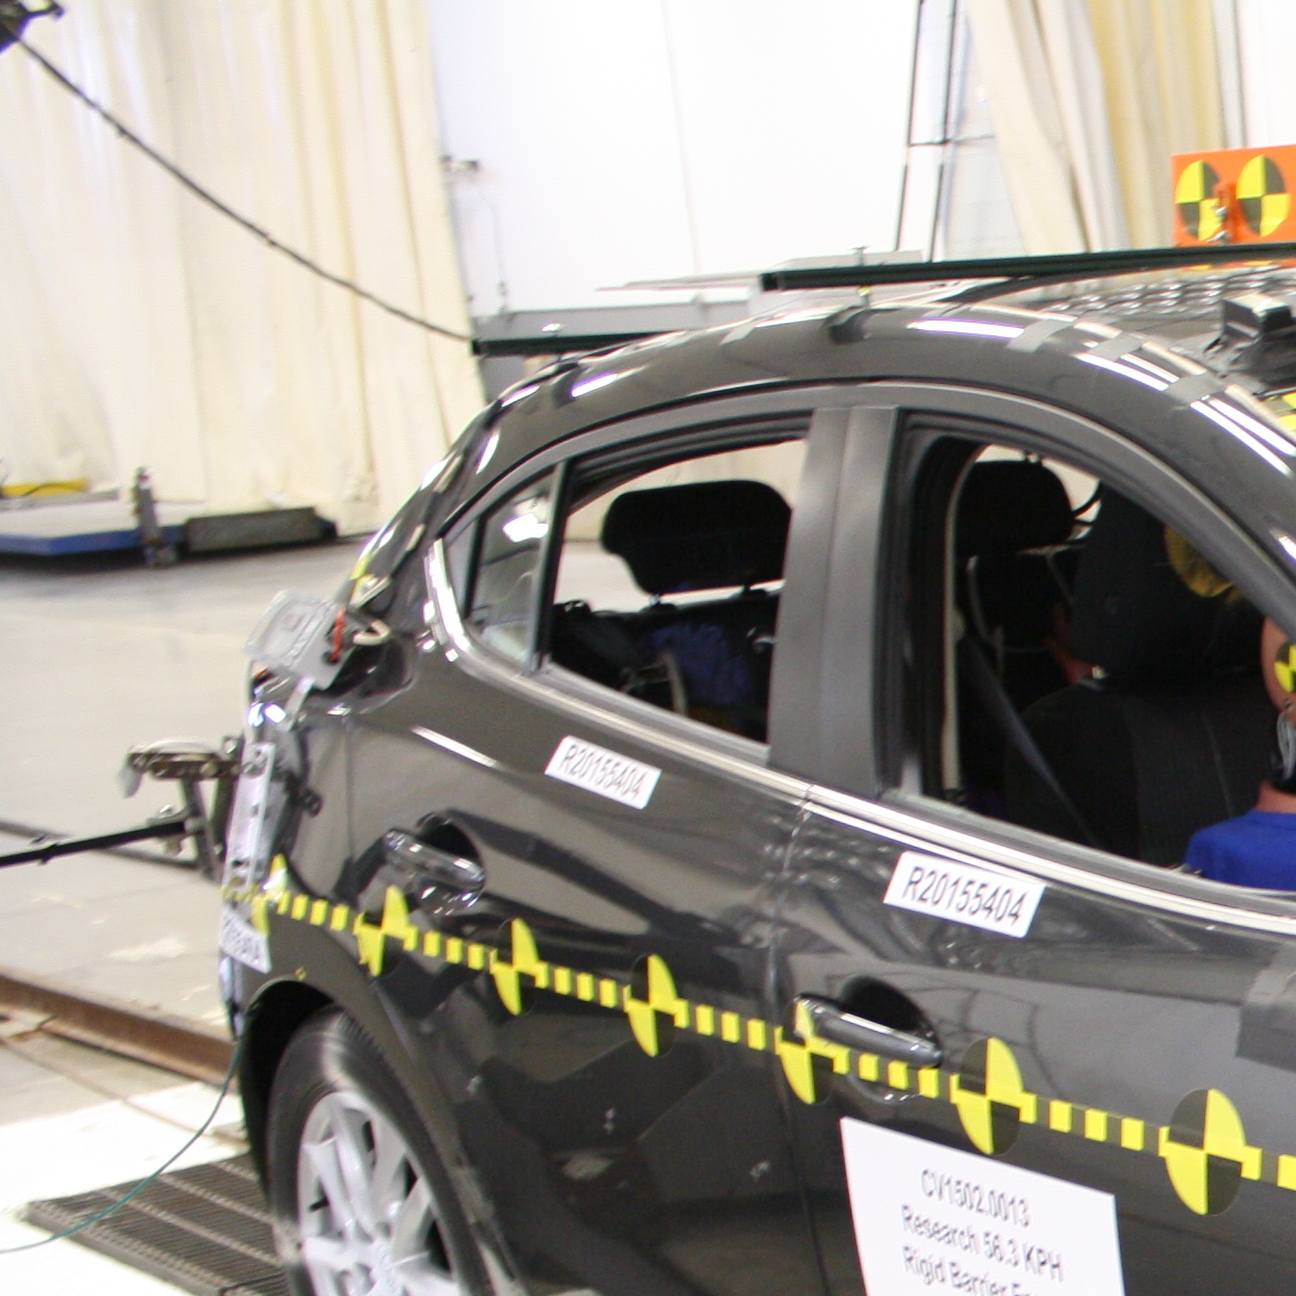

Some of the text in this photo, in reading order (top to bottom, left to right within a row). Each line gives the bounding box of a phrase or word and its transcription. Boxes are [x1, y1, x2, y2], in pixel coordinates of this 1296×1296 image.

[557, 743, 649, 800] R20155404
[902, 866, 1029, 926] R20155404
[920, 1168, 1033, 1229] CV1502.0013
[901, 1205, 1064, 1282] Research 56.3 KPH
[903, 1245, 948, 1286] Rigid
